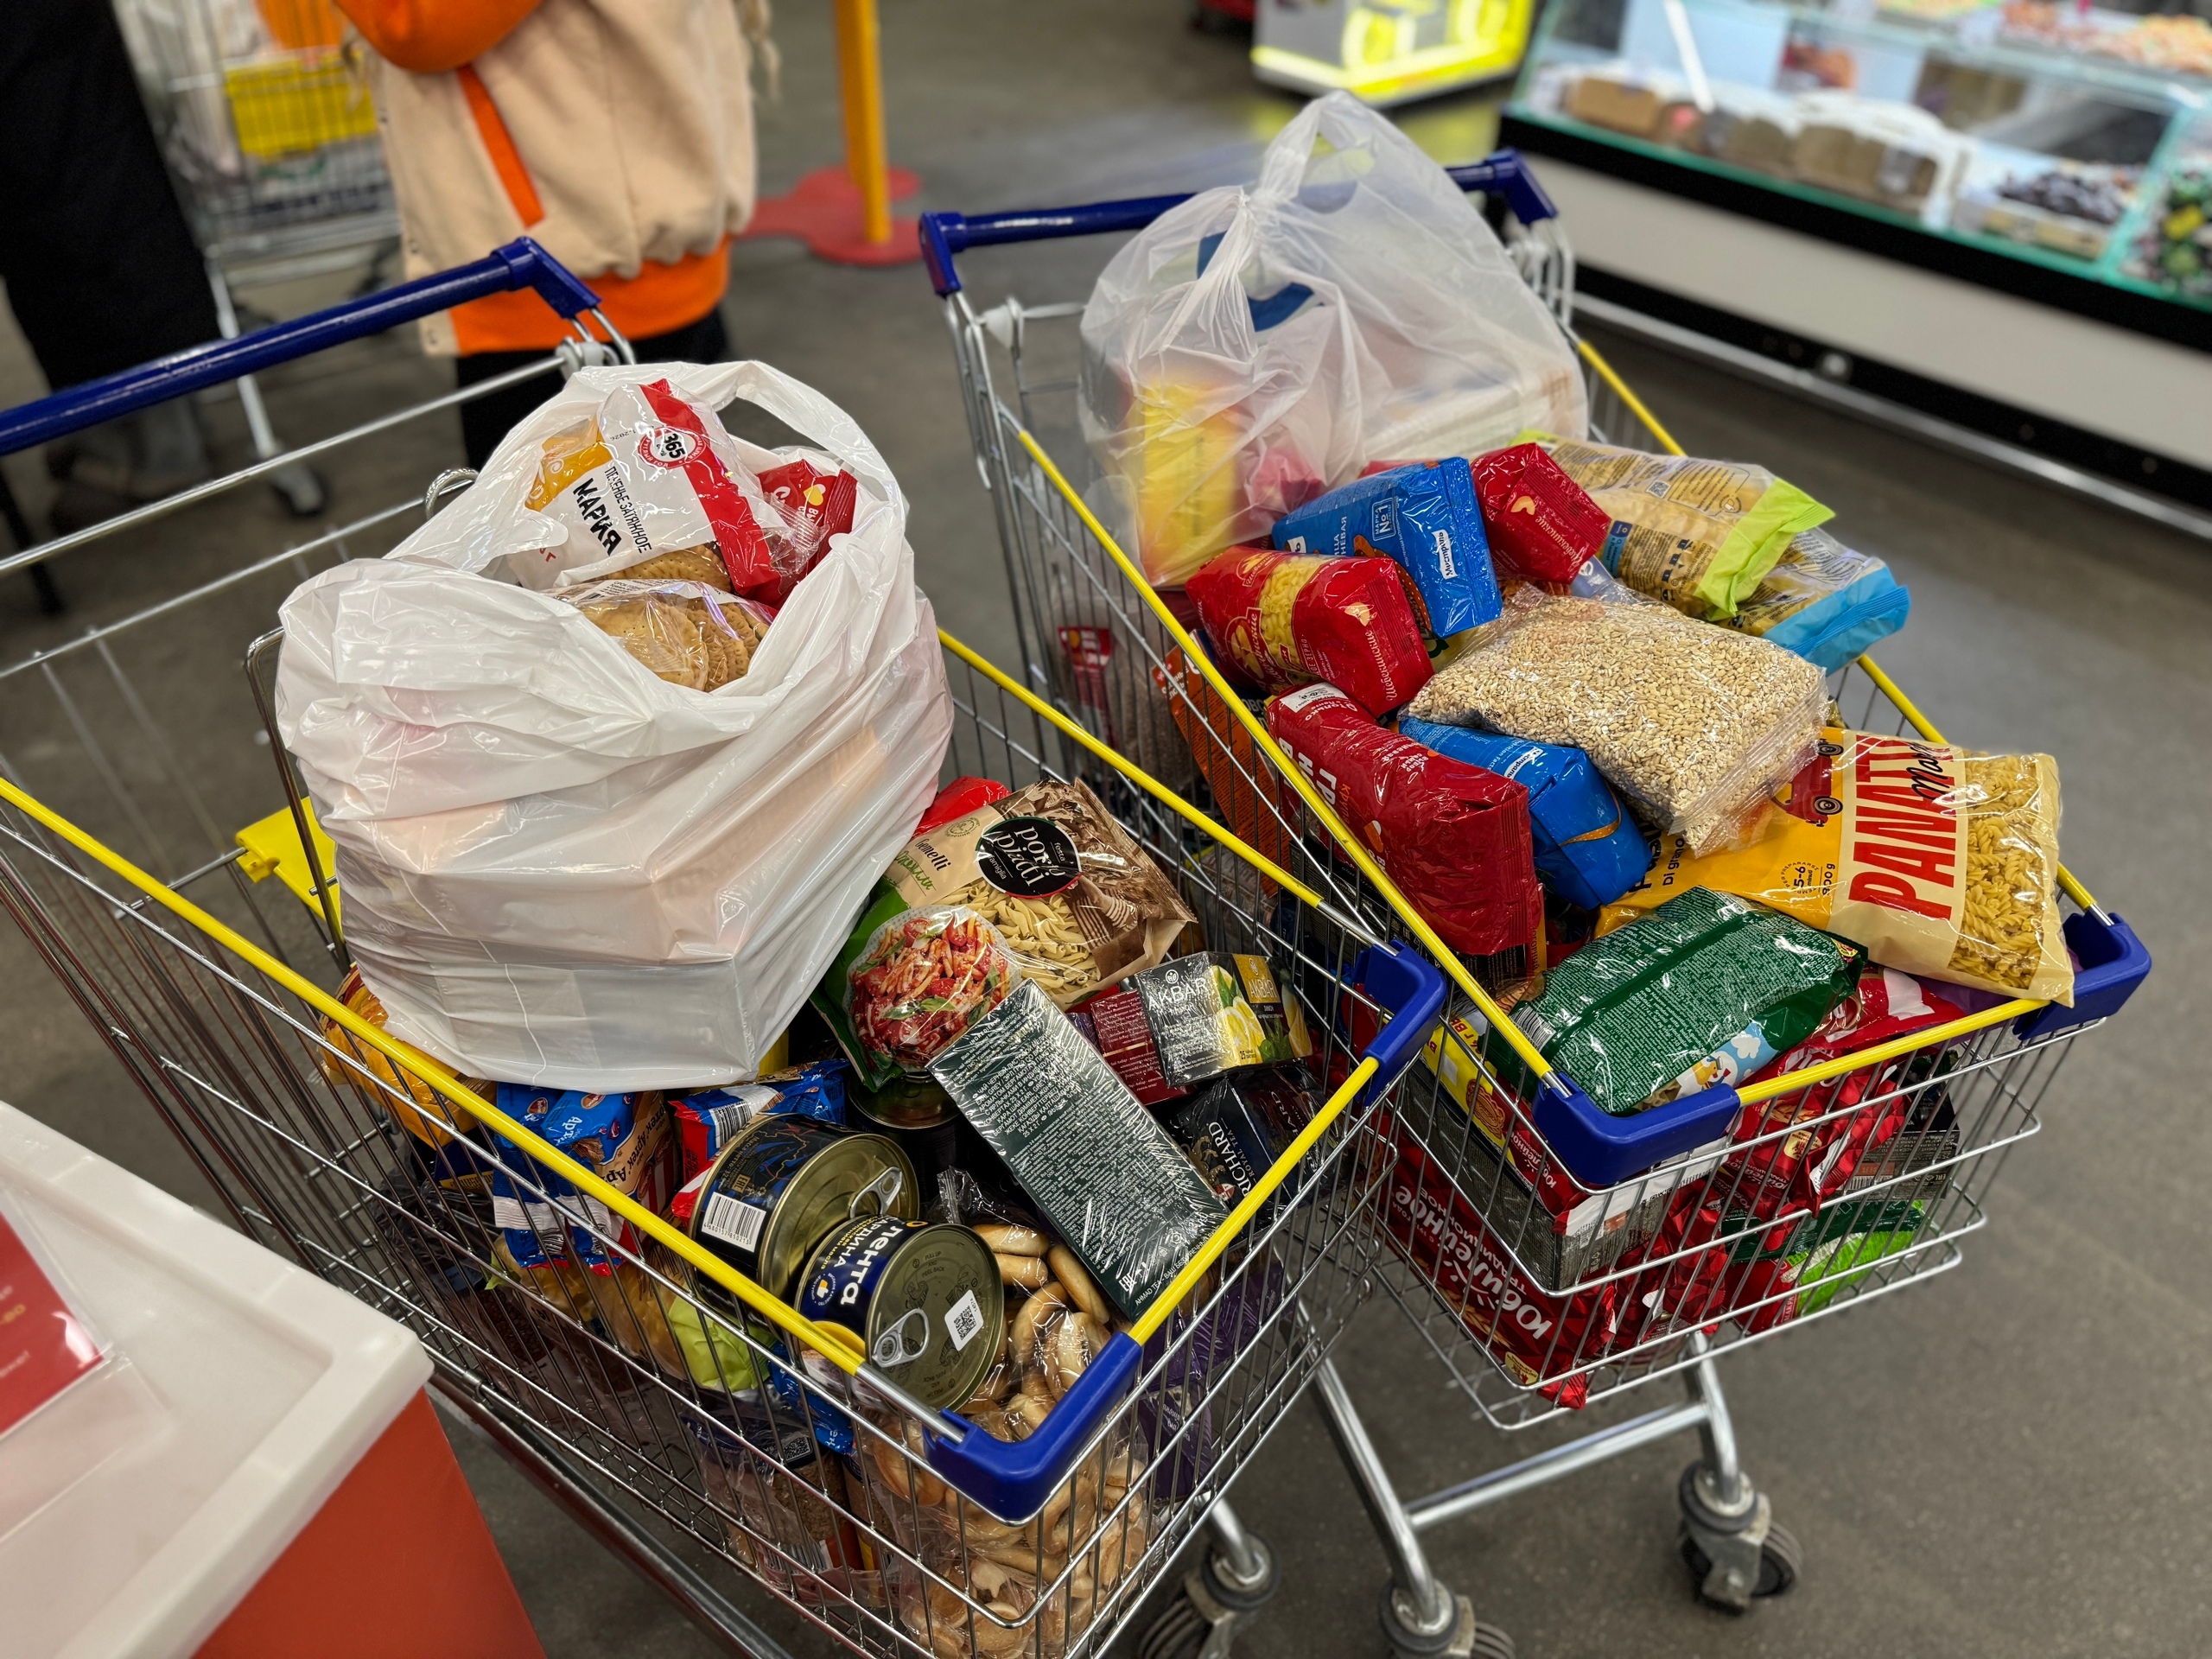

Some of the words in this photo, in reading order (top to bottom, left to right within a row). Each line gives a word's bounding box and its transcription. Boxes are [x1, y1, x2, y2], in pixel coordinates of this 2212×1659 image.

[660, 432, 687, 461] 365
[573, 478, 622, 556] МАРИЯ
[605, 466, 630, 505] ПЕЧЕНЬЕ
[620, 501, 652, 554] ЗАТЯЖНОЕ
[1440, 531, 1452, 576] Мистраль
[1364, 628, 1397, 702] Шебекинские
[1403, 754, 1429, 772] ВЫБОР
[915, 838, 952, 872] Gemelli
[1054, 841, 1066, 862] festa
[1662, 869, 1675, 887] Di
[1669, 837, 1686, 869] grano
[1792, 865, 1807, 887] 5-6
[1148, 978, 1208, 1012] AKBAR
[1249, 979, 1278, 999] AKBAR
[1650, 1014, 1659, 1022] Sof
[1670, 1037, 1680, 1046] 250
[1669, 1016, 1680, 1027] katta
[976, 1084, 989, 1095] ЧАЙ
[987, 1080, 1002, 1096] GREY
[1001, 1070, 1014, 1082] ЭРЛ
[978, 1086, 1007, 1112] АРОМАТОМ
[988, 1084, 1019, 1112] ЯРЛЫЧКАМИ
[1008, 1099, 1022, 1113] ШАЙ
[1021, 1129, 1030, 1138] 25
[1227, 1129, 1238, 1147] TEA
[1208, 1122, 1253, 1198] RICHARD
[1238, 1149, 1255, 1178] ROYAL
[1415, 1182, 1531, 1298] ТРАДИЦИОННОЕ
[925, 1250, 935, 1260] PULL
[1395, 1185, 1553, 1340] Юбилейное
[921, 1267, 933, 1279] PEEL
[932, 1264, 945, 1274] BACK
[1133, 1287, 1154, 1306] AHMAD
